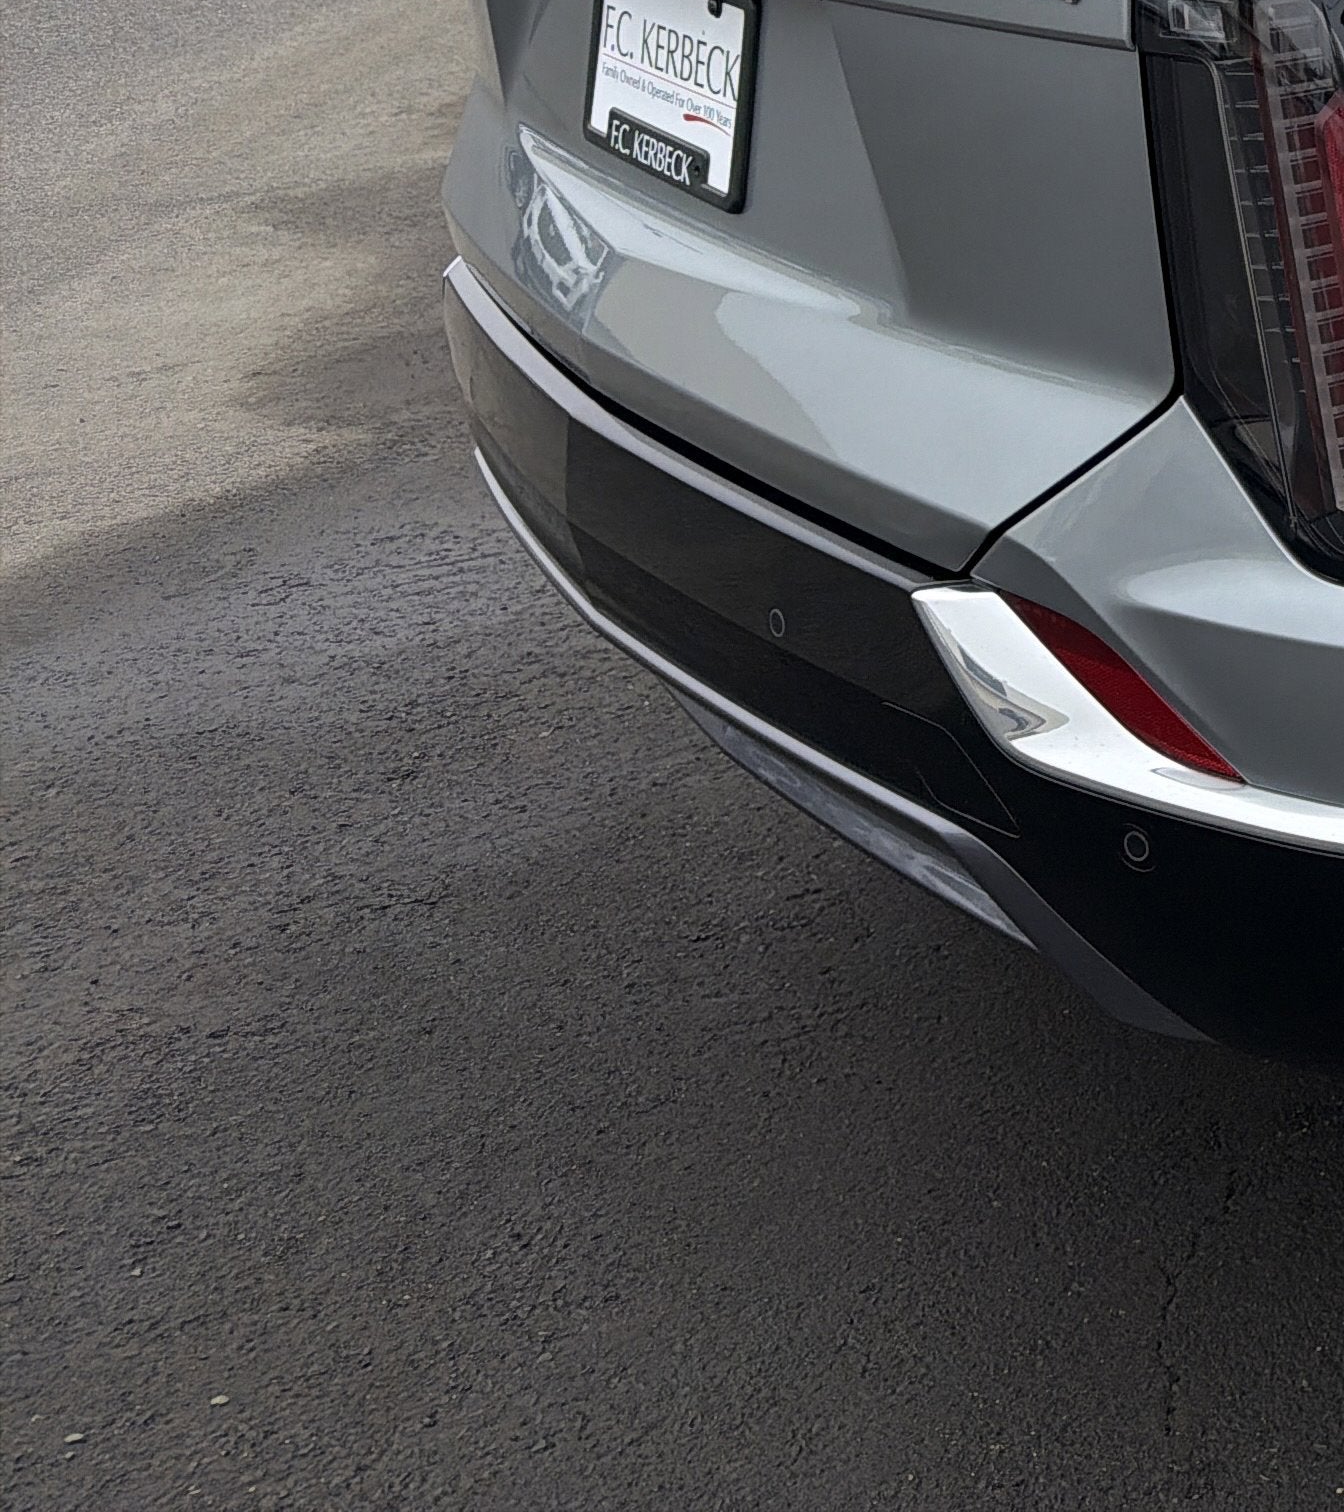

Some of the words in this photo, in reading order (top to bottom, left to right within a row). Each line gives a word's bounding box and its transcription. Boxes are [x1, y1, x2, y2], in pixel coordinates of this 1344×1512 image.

[603, 4, 634, 61] F.C.
[640, 18, 740, 103] KERBECK
[620, 68, 641, 91] Owned
[647, 80, 675, 106] Operated
[674, 92, 686, 108] For
[686, 97, 703, 115] Over
[703, 104, 716, 121] 100
[716, 109, 734, 129] Years
[632, 129, 694, 187] KERBECK
